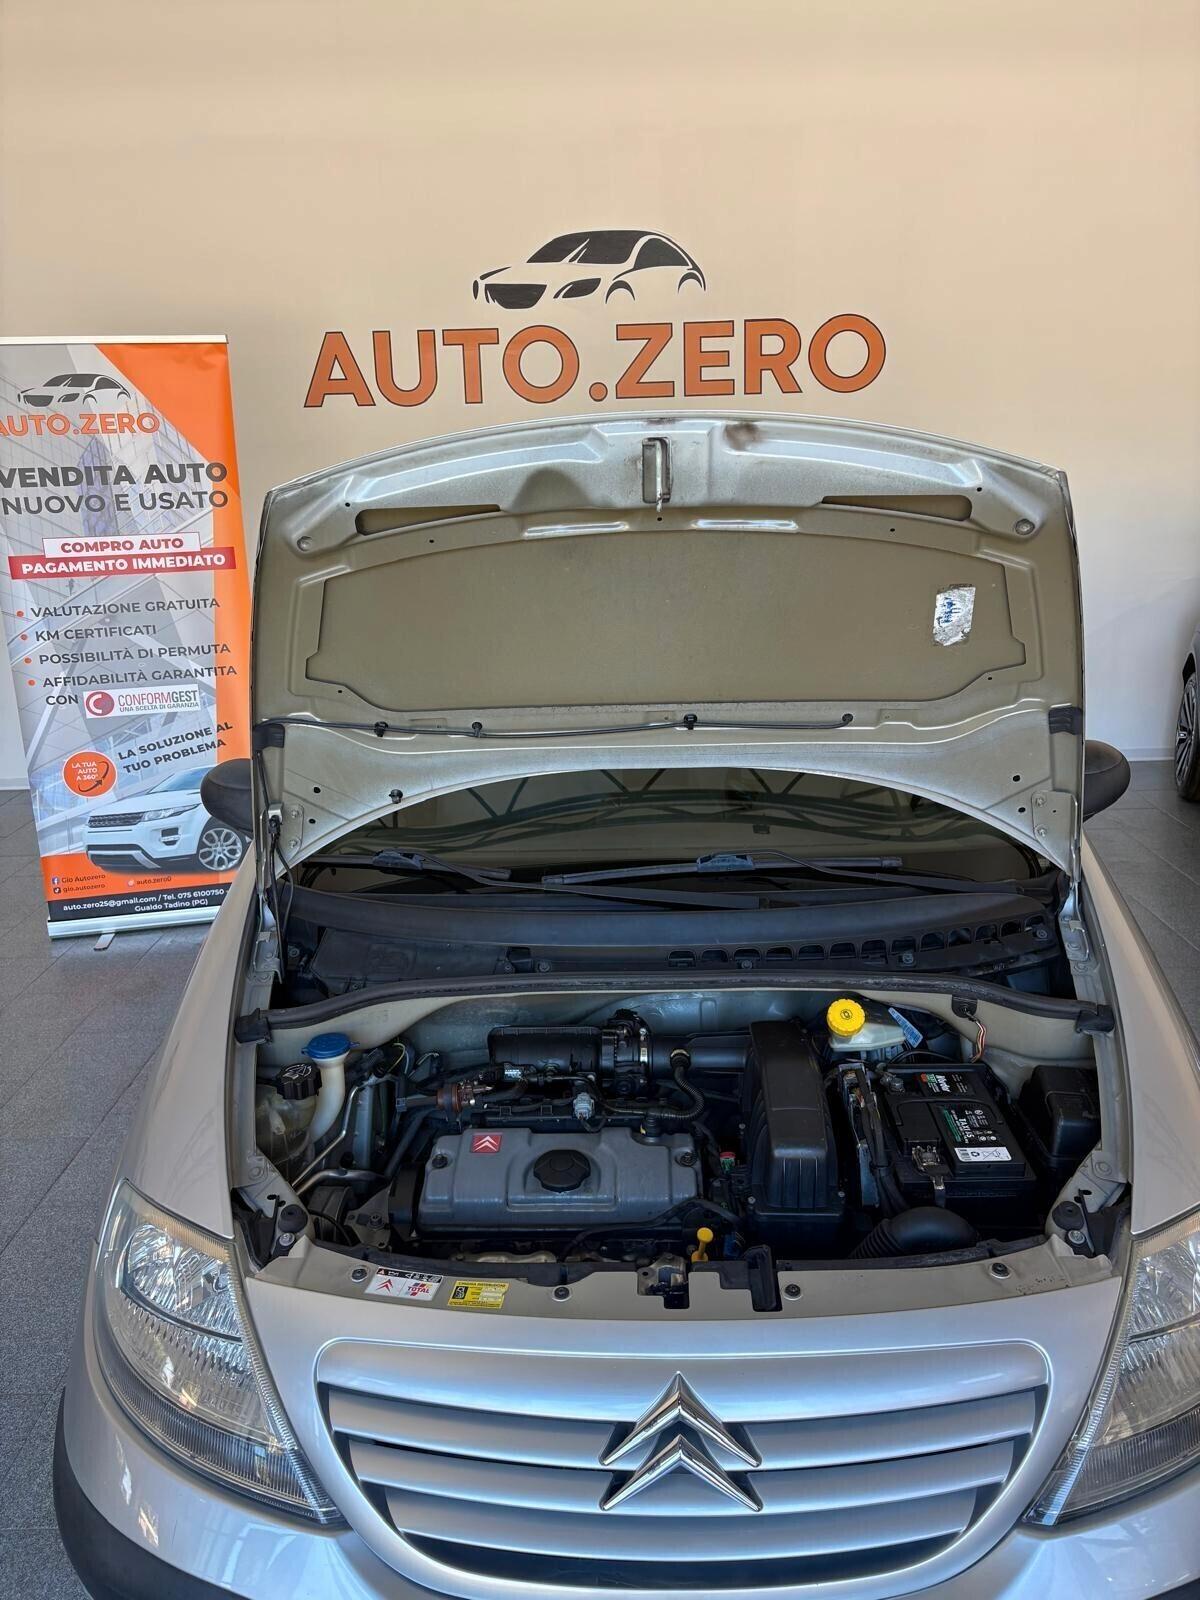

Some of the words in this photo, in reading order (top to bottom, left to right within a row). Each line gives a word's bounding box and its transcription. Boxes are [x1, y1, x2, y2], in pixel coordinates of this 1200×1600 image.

[304, 313, 887, 407] AUTO.ZERO
[0, 465, 136, 488] VENDITA
[144, 462, 227, 484] AUTO
[2, 494, 106, 515] NUOVO
[116, 493, 130, 511] E
[140, 490, 228, 511] USATO
[60, 540, 134, 554] COMPRO
[139, 537, 184, 550] AUTO
[22, 557, 128, 574] PAGAMENTO
[133, 553, 226, 570] IMMEDIATO
[31, 602, 141, 618] VALUTAZIONE
[145, 598, 220, 612] GRATUITA
[35, 630, 60, 642] KM
[64, 624, 157, 640] CERTIFICATI
[39, 648, 134, 665] POSSIBILITÀ
[138, 648, 154, 659] DI
[158, 643, 231, 658] PERMUTA
[42, 669, 148, 688] AFFIDABILITÀ
[151, 665, 237, 681] GARANTITA
[45, 694, 79, 706] CON
[118, 690, 198, 707] CONFORMGEST
[118, 749, 136, 761] LA
[138, 726, 213, 754] SOLUZIONE
[215, 721, 233, 735] AL
[123, 760, 151, 774] TUO
[154, 738, 226, 766] PROBLEMA
[77, 767, 98, 775] AUTO
[74, 874, 106, 882] Autozero
[177, 891, 192, 899] 075
[134, 902, 162, 912] Gualdo
[163, 899, 191, 909] Tadino
[191, 898, 208, 907] (PG)
[407, 1285, 430, 1294] TOTAL
